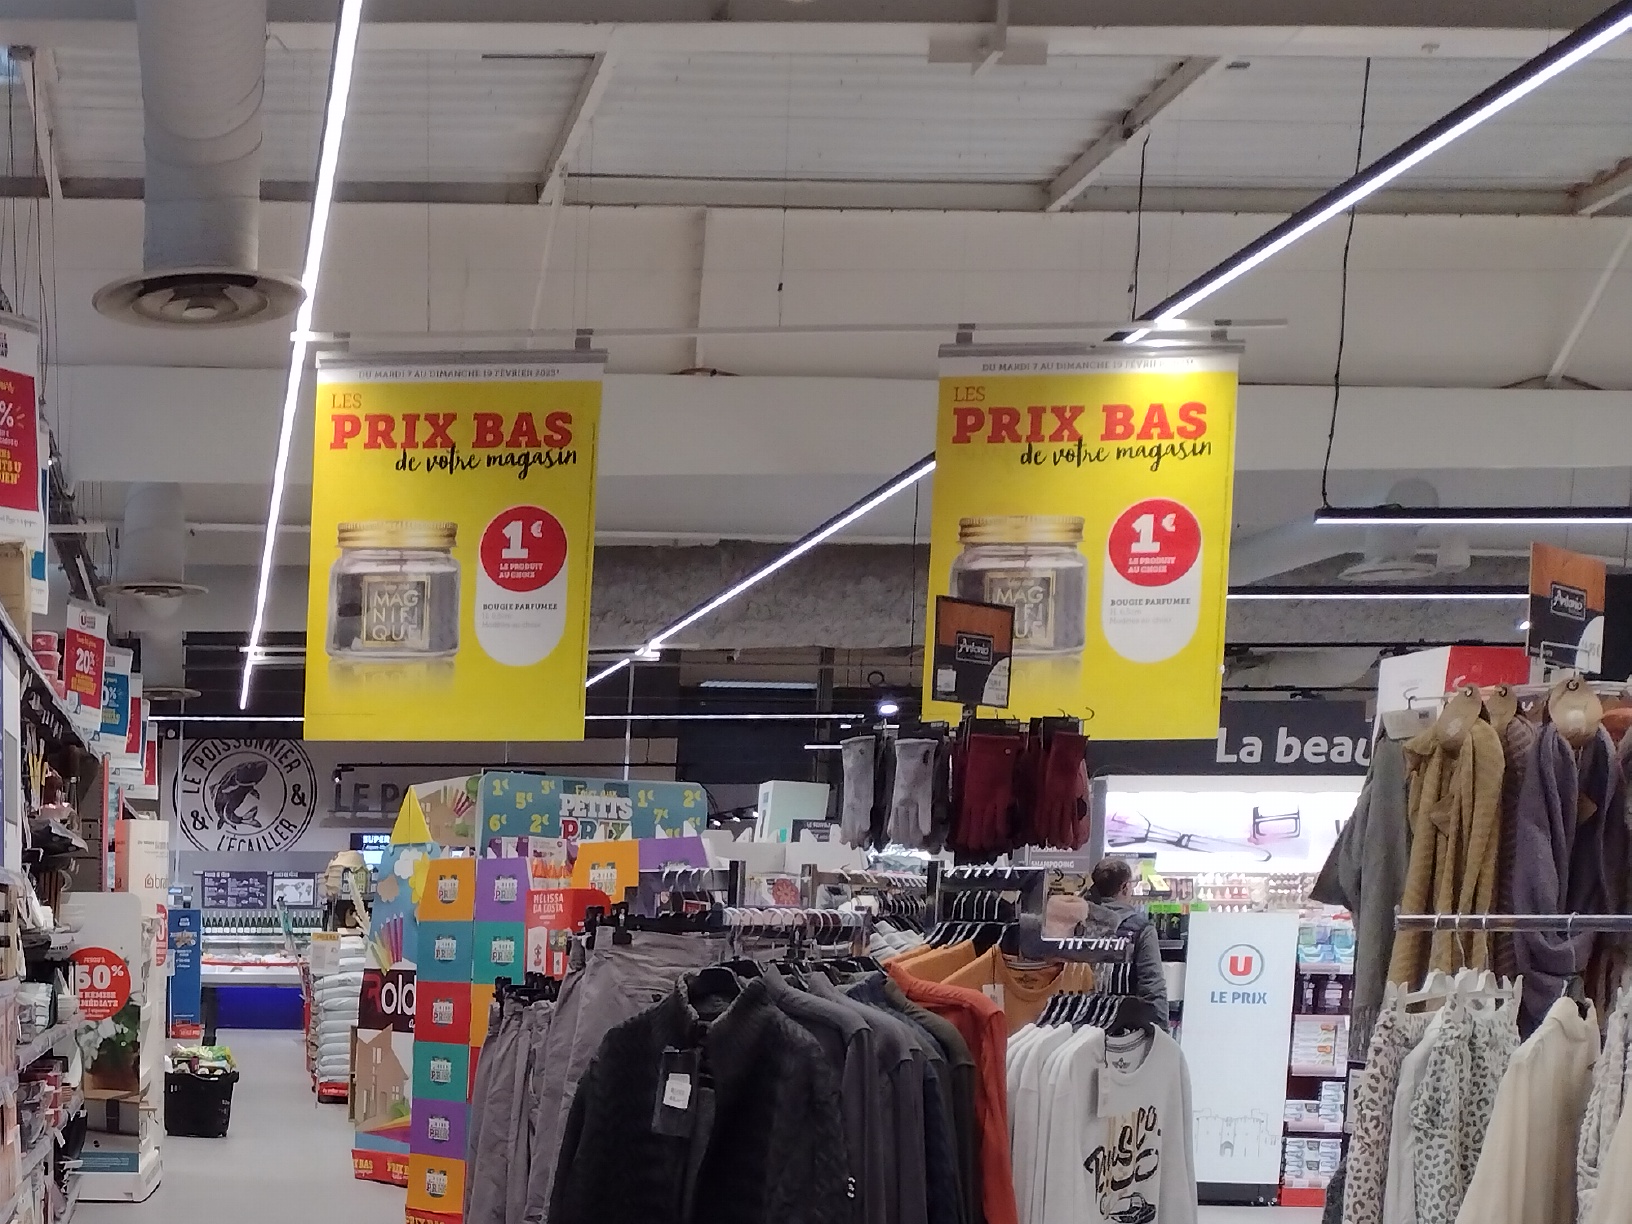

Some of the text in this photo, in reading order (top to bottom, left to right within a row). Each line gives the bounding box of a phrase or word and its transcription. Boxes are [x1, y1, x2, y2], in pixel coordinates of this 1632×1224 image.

[375, 370, 406, 378] MARDI
[414, 369, 427, 378] AU
[429, 369, 480, 378] DIMANCHE
[982, 363, 996, 371] DU
[999, 362, 1030, 371] MARDI
[1033, 362, 1038, 370] 7
[1040, 362, 1054, 370] AU
[1057, 361, 1108, 370] DIMANCHE
[331, 393, 362, 409] LES
[953, 386, 985, 402] LES
[952, 401, 1207, 443] PRIX BAS
[330, 411, 573, 450] PRIX BAS
[395, 442, 577, 480] de votre magasin
[1020, 436, 1212, 472] de votre magasin
[510, 563, 543, 571] PRODUIT
[1139, 556, 1176, 565] PRODUIT
[1128, 565, 1140, 573] AU
[483, 603, 513, 611] BOUGIE
[1110, 598, 1143, 608] BOUGIE
[1216, 727, 1263, 764] La
[559, 794, 633, 819] PETITS
[533, 892, 564, 904] MÉLISSA
[1229, 956, 1253, 977] U
[1210, 991, 1268, 1005] LE PRIX
